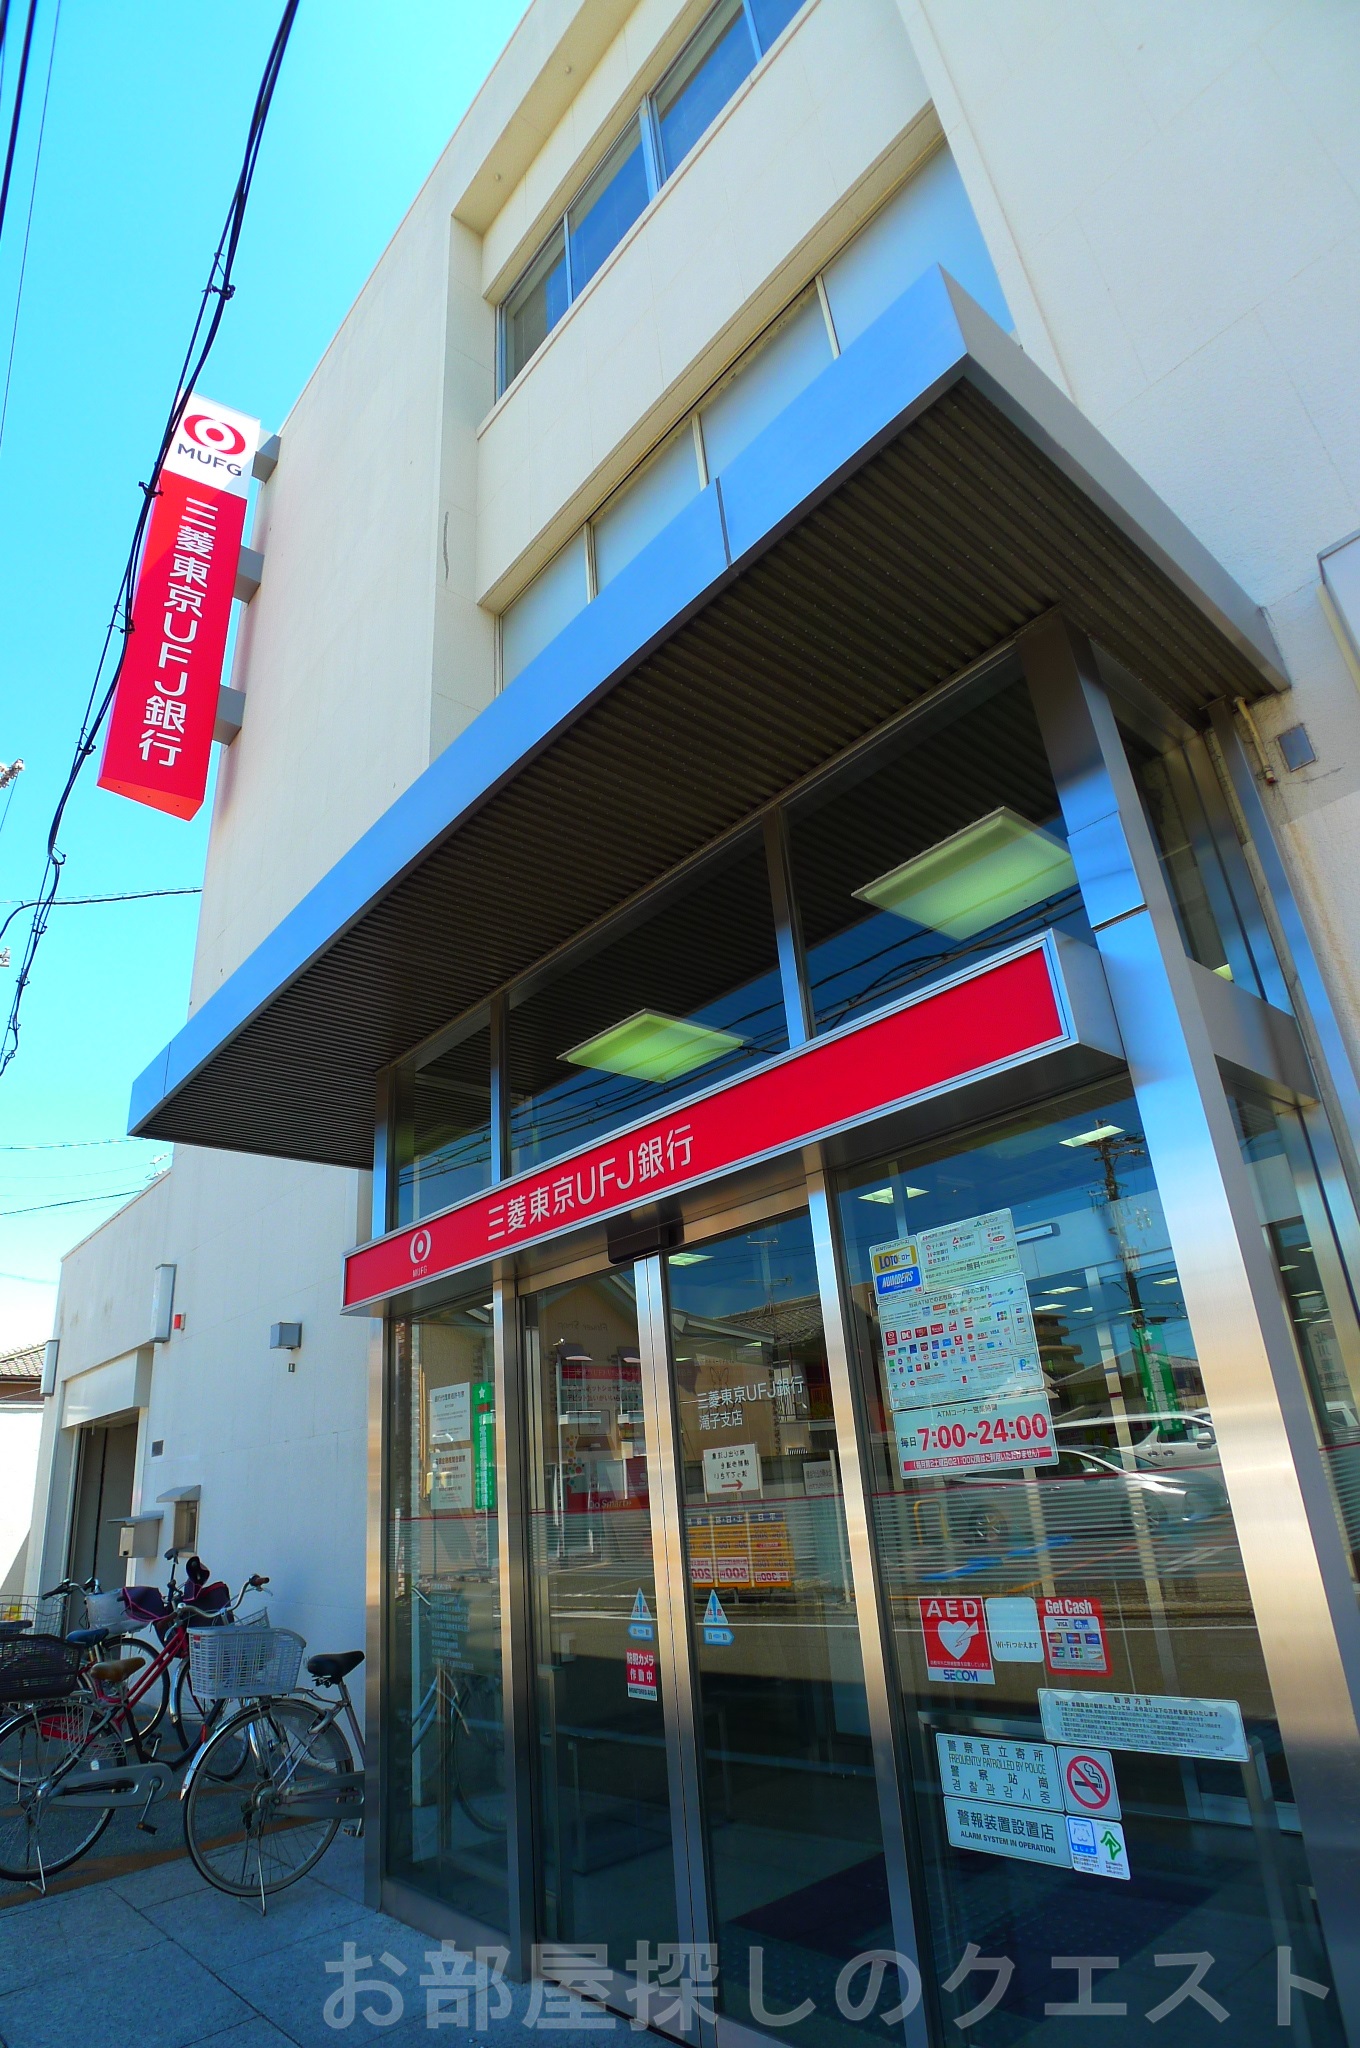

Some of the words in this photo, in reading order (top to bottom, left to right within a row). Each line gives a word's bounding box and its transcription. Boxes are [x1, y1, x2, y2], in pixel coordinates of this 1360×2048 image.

[177, 444, 243, 477] MUFG
[138, 495, 219, 768] 三菱東京UFJ銀行
[487, 1124, 694, 1242] 三菱東京UFJ銀行
[879, 1255, 899, 1270] LOTO
[412, 1266, 428, 1278] MUFG
[882, 1271, 914, 1288] NUMBERS
[697, 1375, 804, 1410] 三菱東京UFJ銀行
[900, 1436, 917, 1448] 毎日
[926, 1600, 978, 1618] AED
[1045, 1599, 1064, 1614] Get
[1065, 1599, 1093, 1614] Cash
[626, 1652, 655, 1666] 防犯カメラ
[630, 1668, 653, 1683] 作動中
[943, 1669, 979, 1682] SECOM
[948, 1753, 982, 1766] FREQUENTLY
[983, 1757, 1015, 1771] PATROLLED
[1015, 1761, 1024, 1771] BY
[1025, 1763, 1047, 1775] POLICE
[957, 1809, 1055, 1841] 警報装置設置店
[960, 1830, 982, 1840] ALARM
[983, 1834, 1009, 1846] SYSTEM
[1010, 1839, 1017, 1847] IN
[1018, 1841, 1056, 1855] OPERATION
